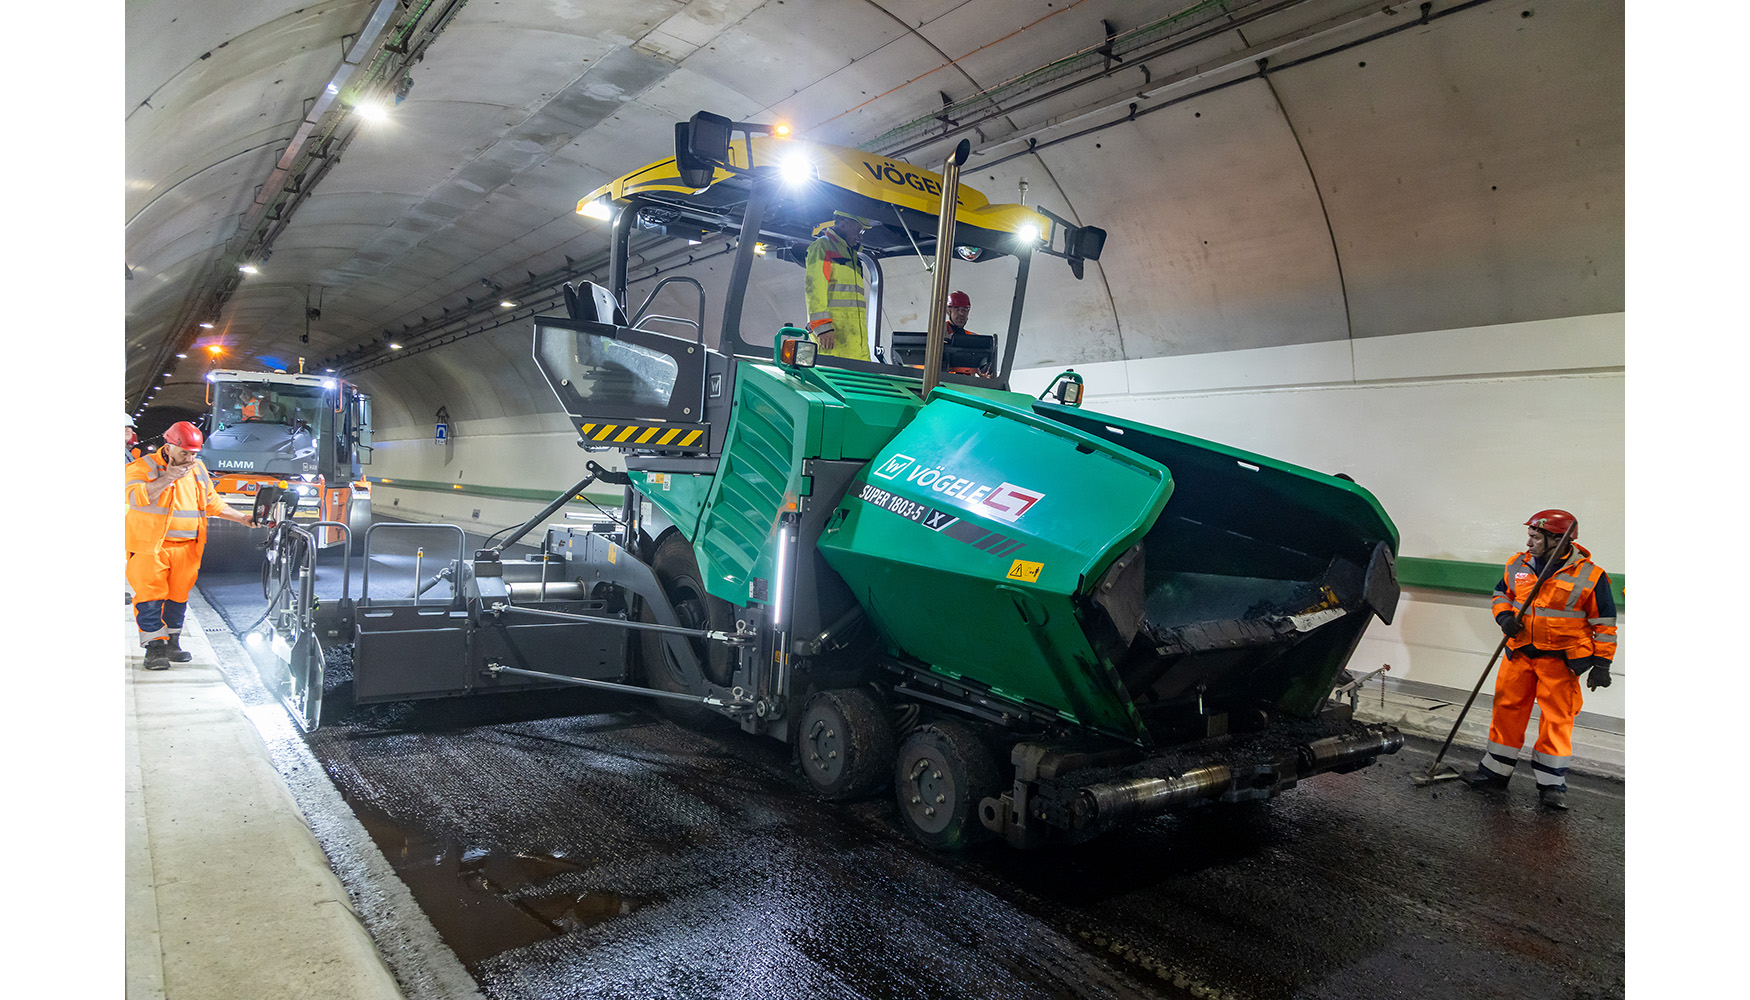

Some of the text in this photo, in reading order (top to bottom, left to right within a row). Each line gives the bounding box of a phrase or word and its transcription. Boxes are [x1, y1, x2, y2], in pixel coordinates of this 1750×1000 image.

[863, 162, 963, 205] VÖGE
[218, 460, 254, 469] HAMM
[859, 485, 891, 507] SUPER
[888, 496, 925, 520] 1803-5
[907, 465, 992, 504] VÖGELE
